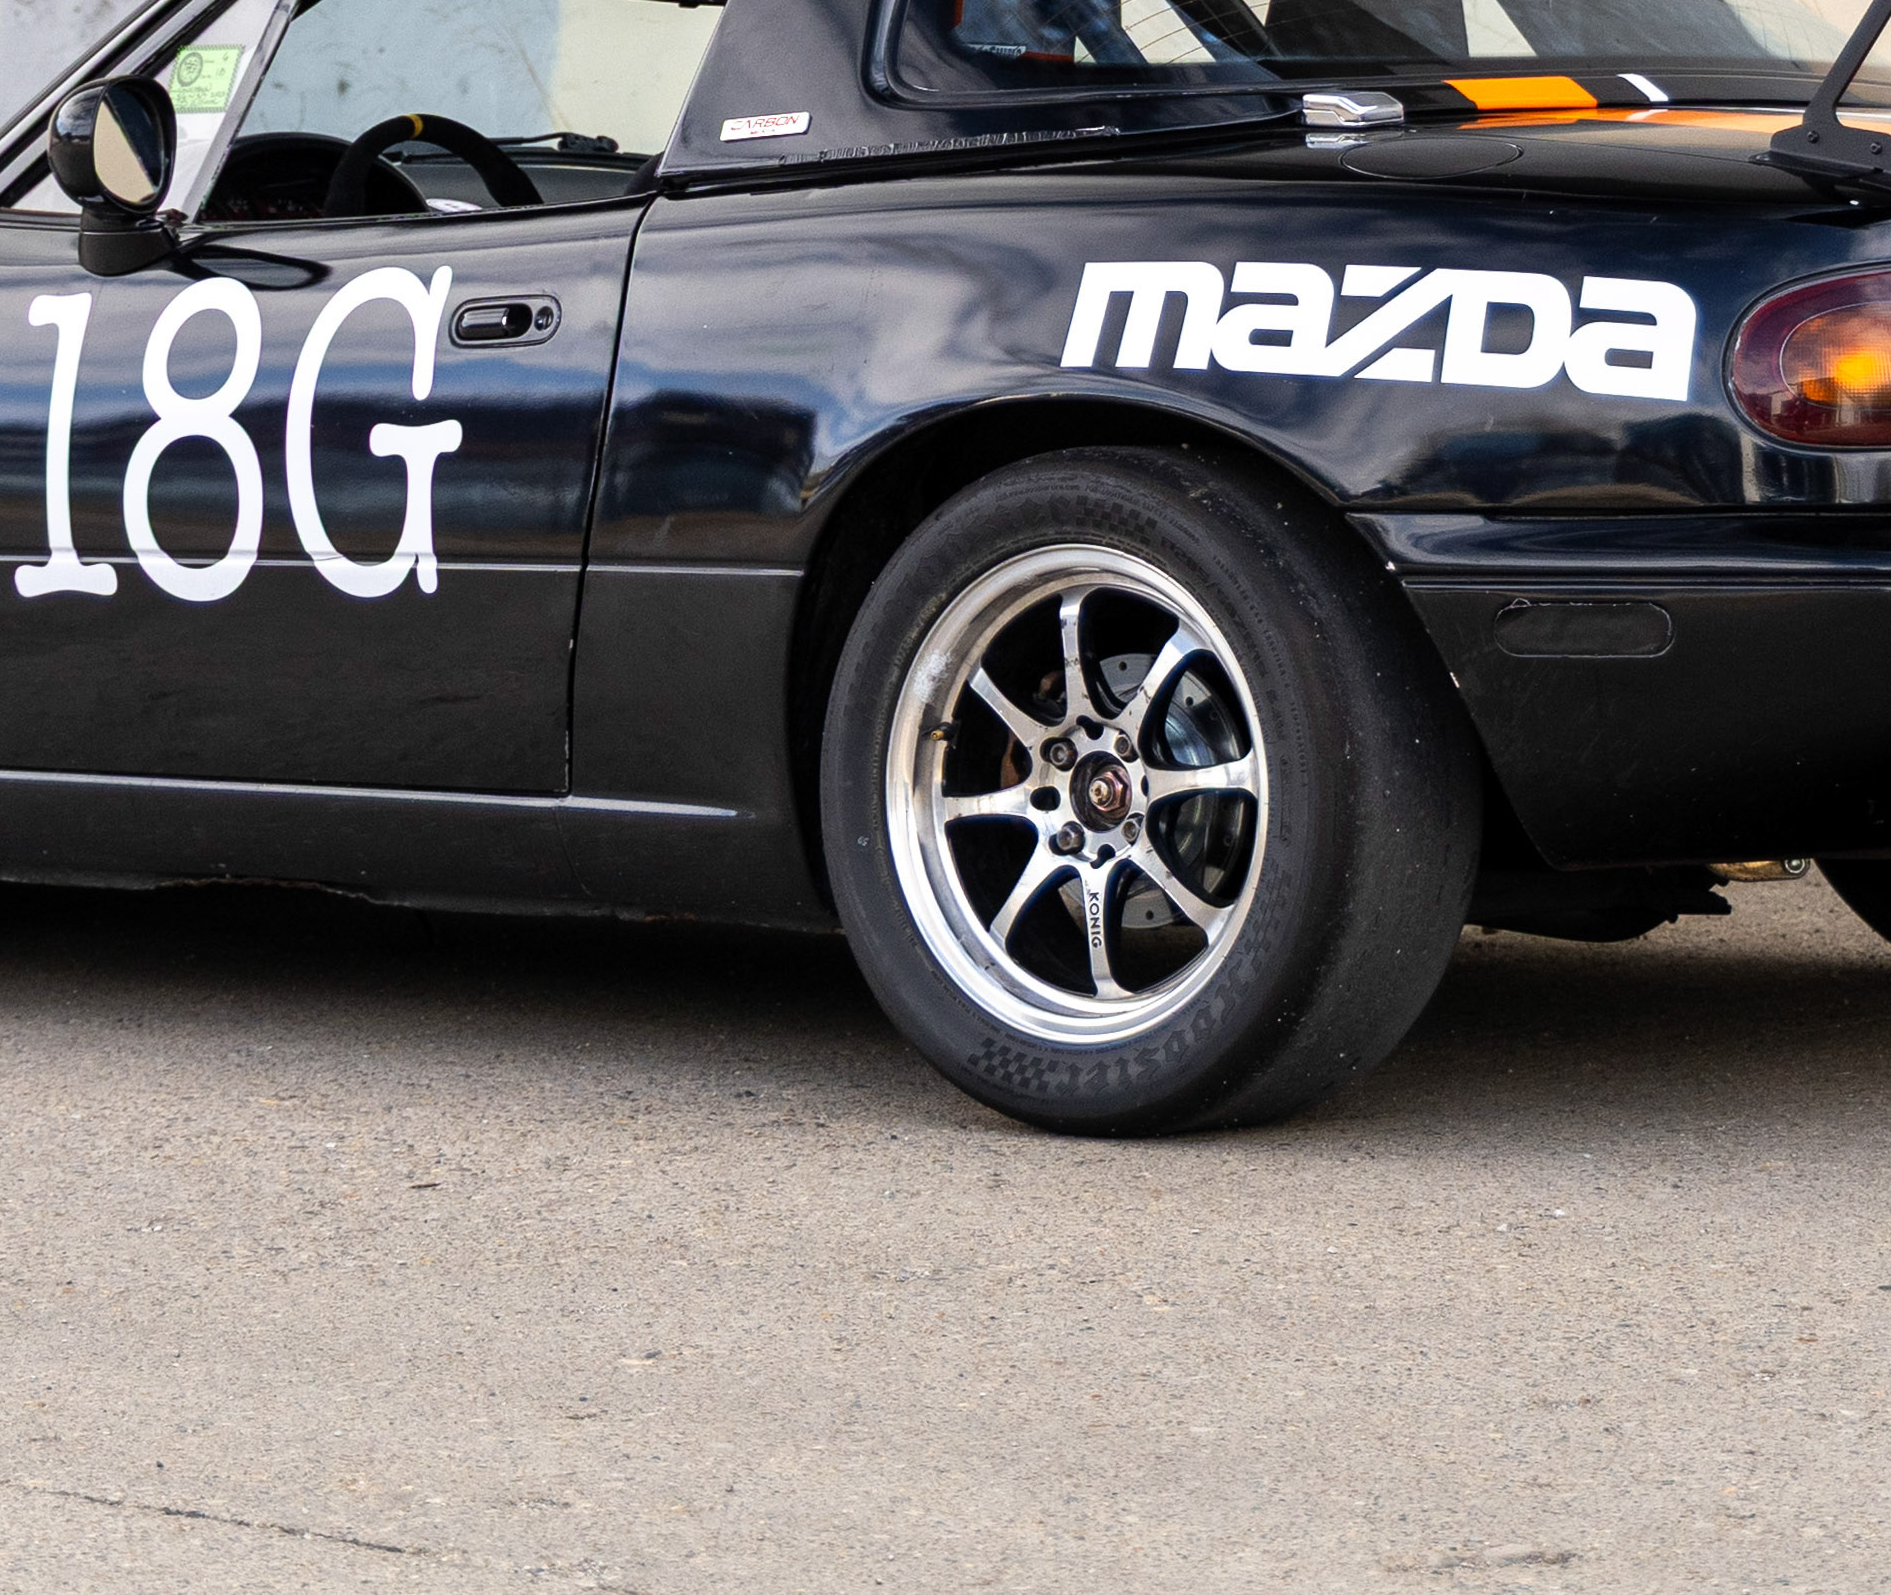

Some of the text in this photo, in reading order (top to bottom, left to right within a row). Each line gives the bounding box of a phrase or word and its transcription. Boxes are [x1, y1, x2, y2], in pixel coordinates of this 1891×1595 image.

[730, 114, 801, 131] CARBON
[14, 265, 463, 603] 18G
[1089, 891, 1103, 949] KONIG
